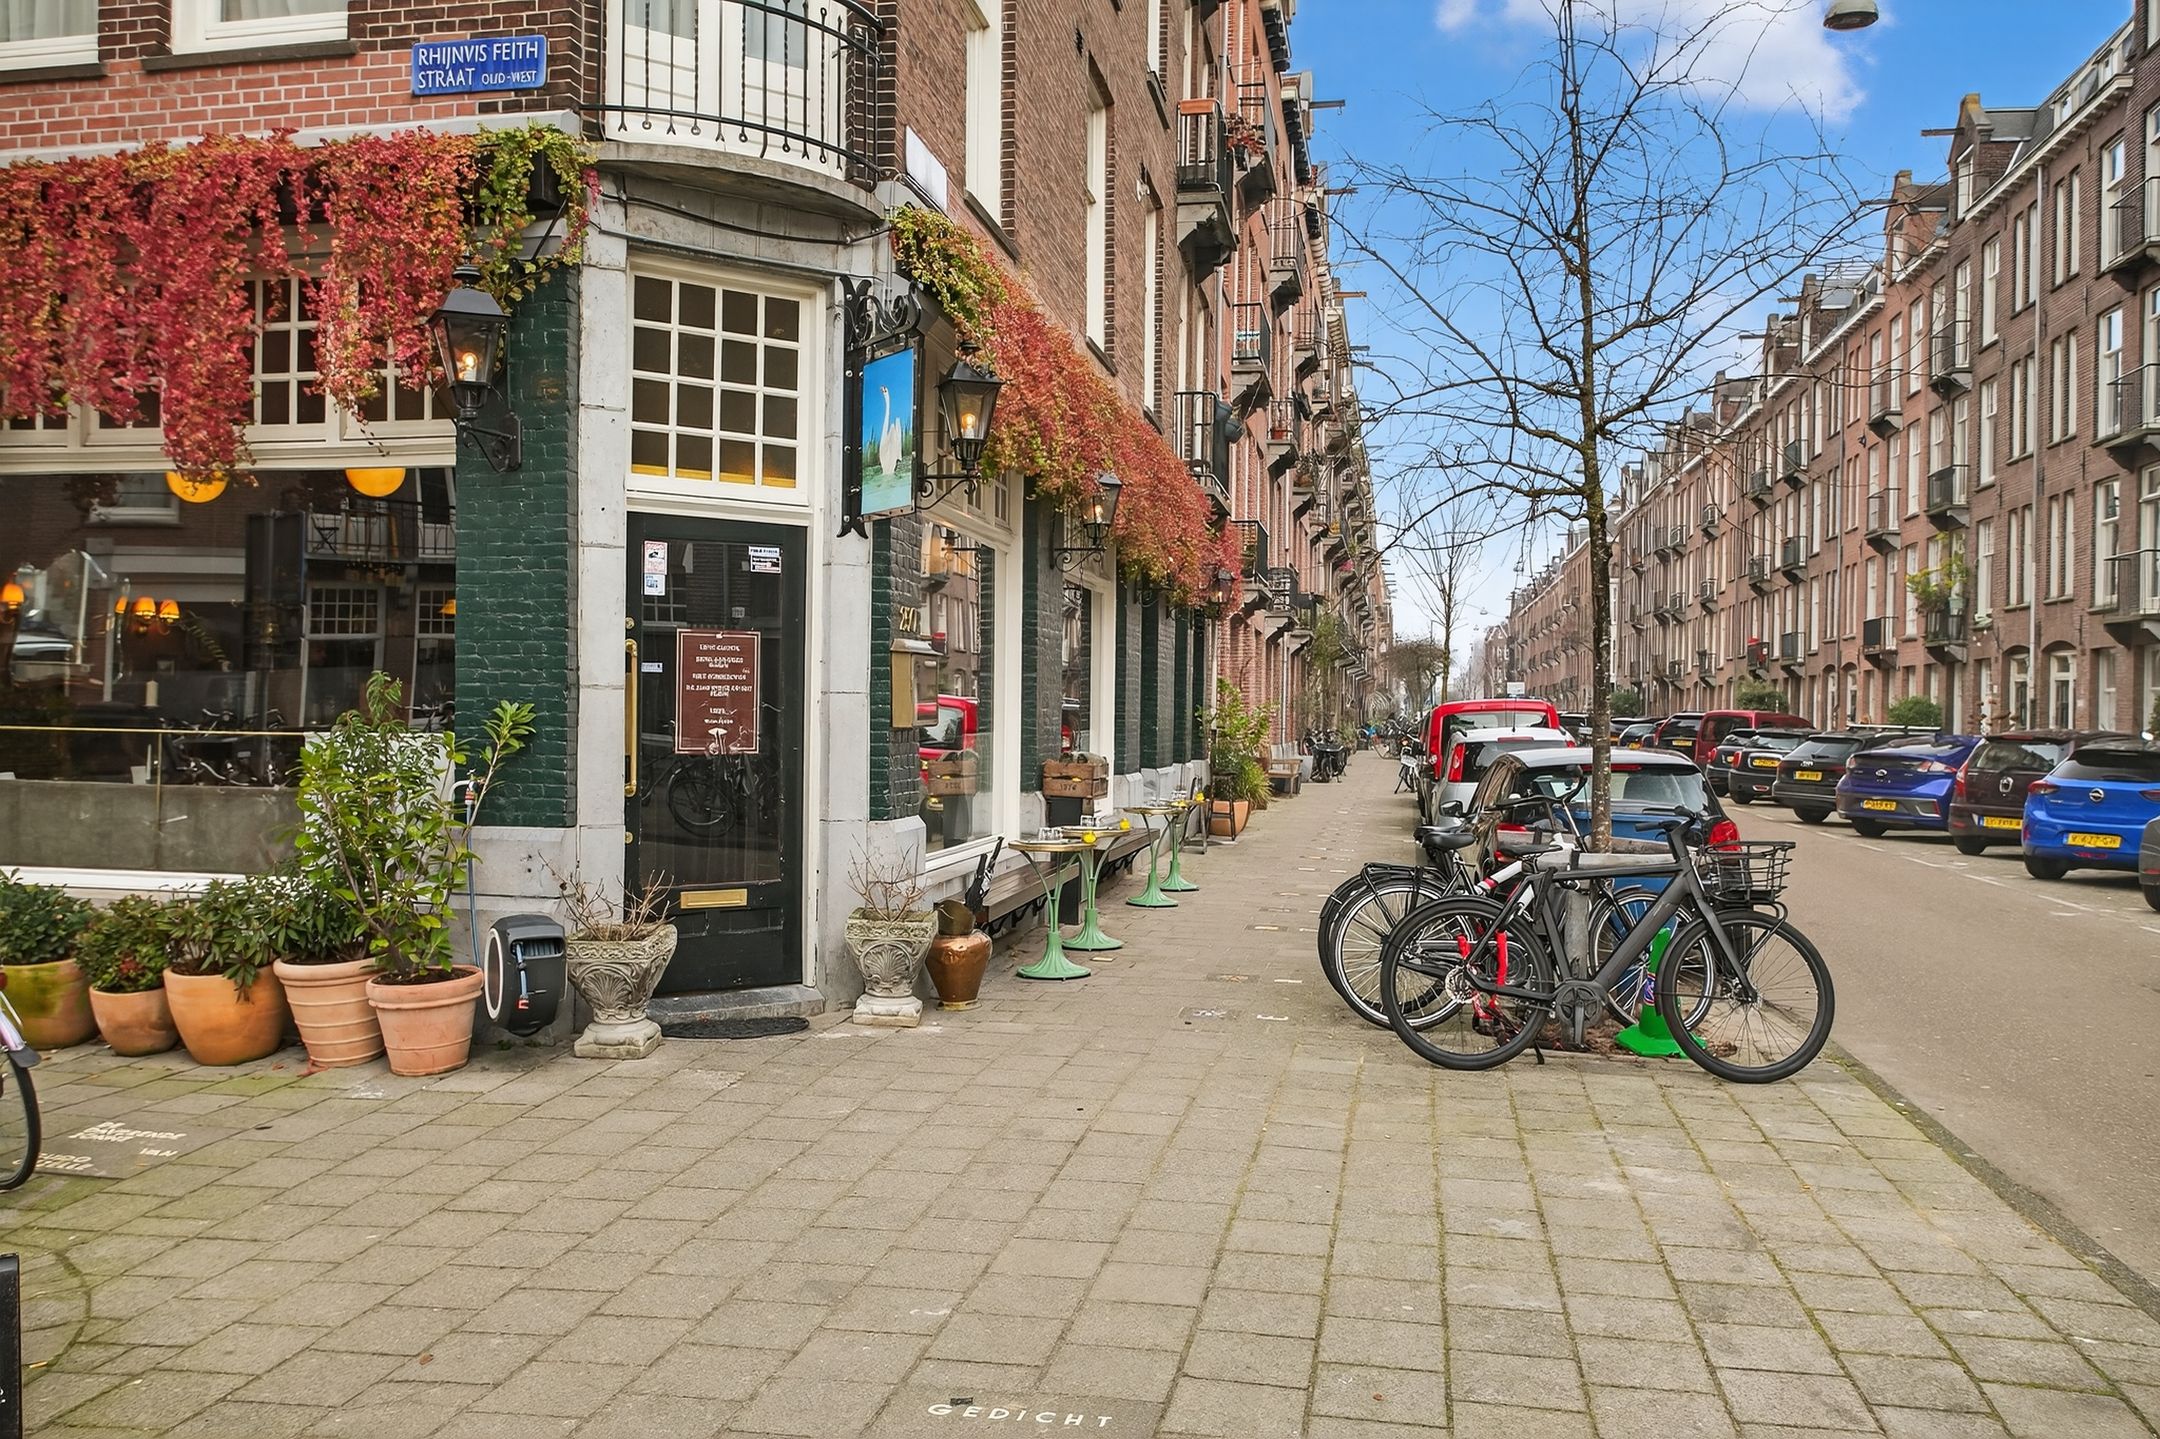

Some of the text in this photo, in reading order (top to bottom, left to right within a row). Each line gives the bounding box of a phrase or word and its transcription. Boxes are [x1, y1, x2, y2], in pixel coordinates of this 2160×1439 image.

[418, 41, 539, 70] RHIJNVIS FEITH
[418, 67, 537, 89] STRAAT OUD-WEST
[927, 1403, 1113, 1428] GEDICHT
